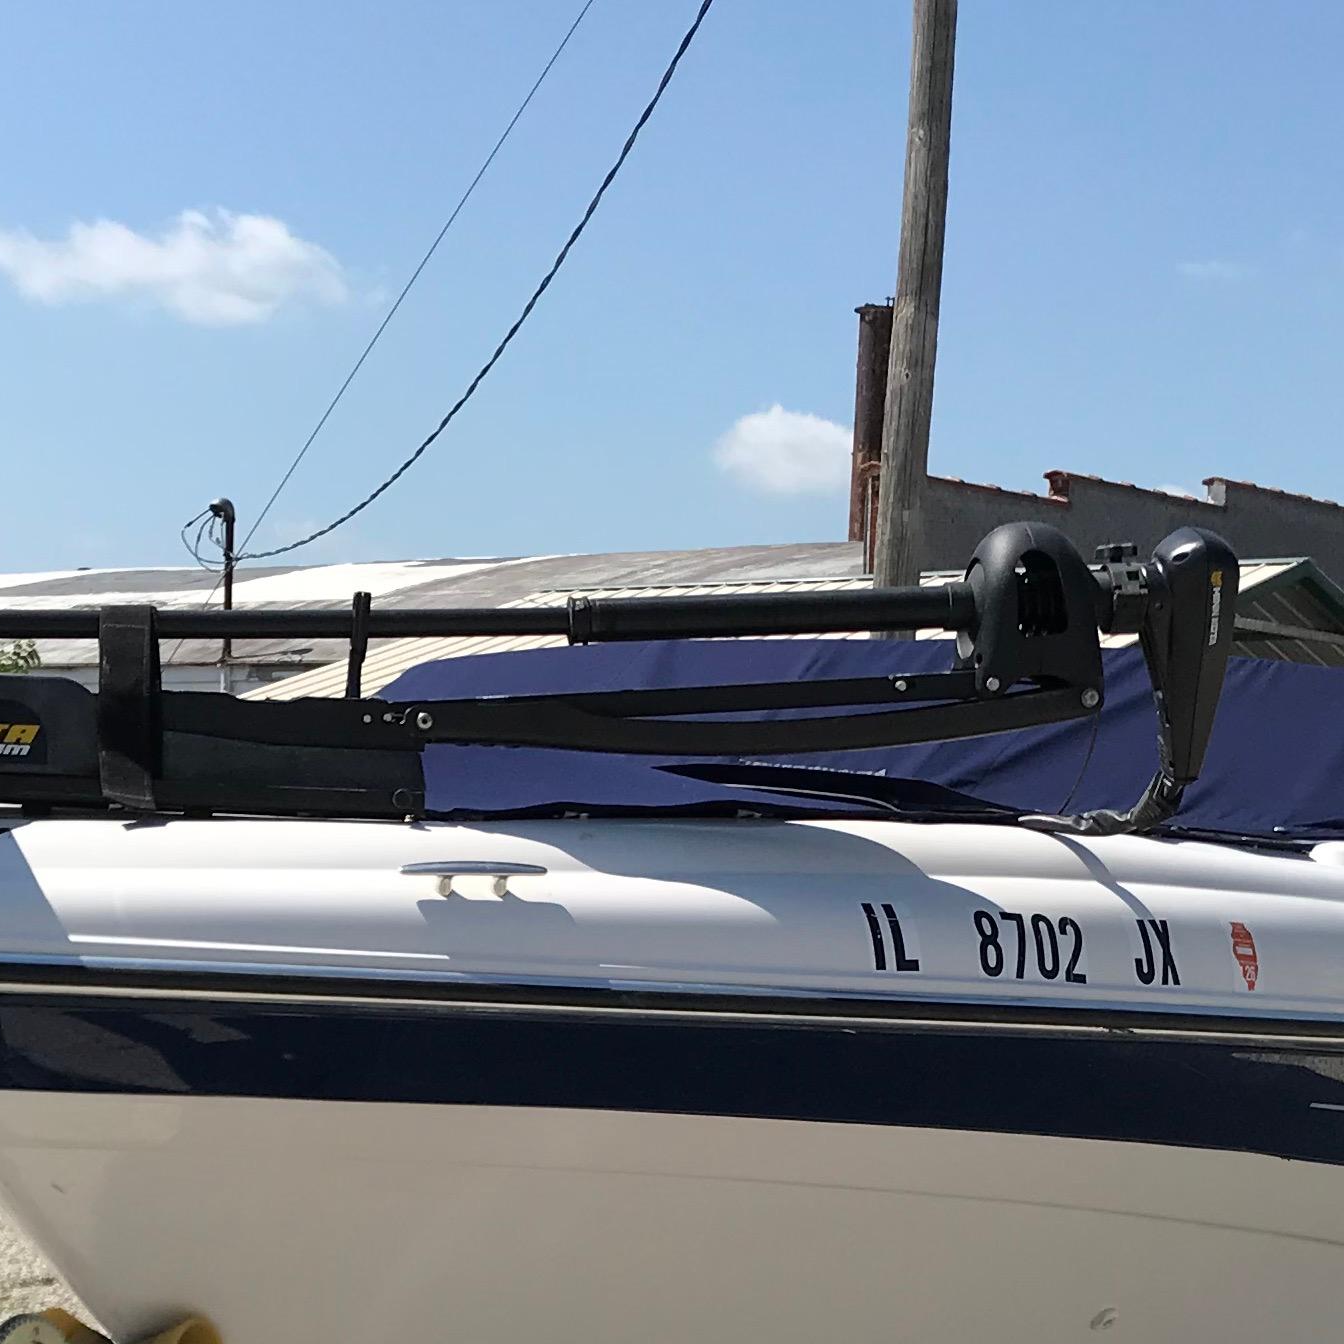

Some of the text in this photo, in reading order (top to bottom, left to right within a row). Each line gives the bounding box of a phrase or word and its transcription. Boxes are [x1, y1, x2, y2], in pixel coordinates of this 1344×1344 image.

[860, 902, 1182, 986] IL 8702 JX
